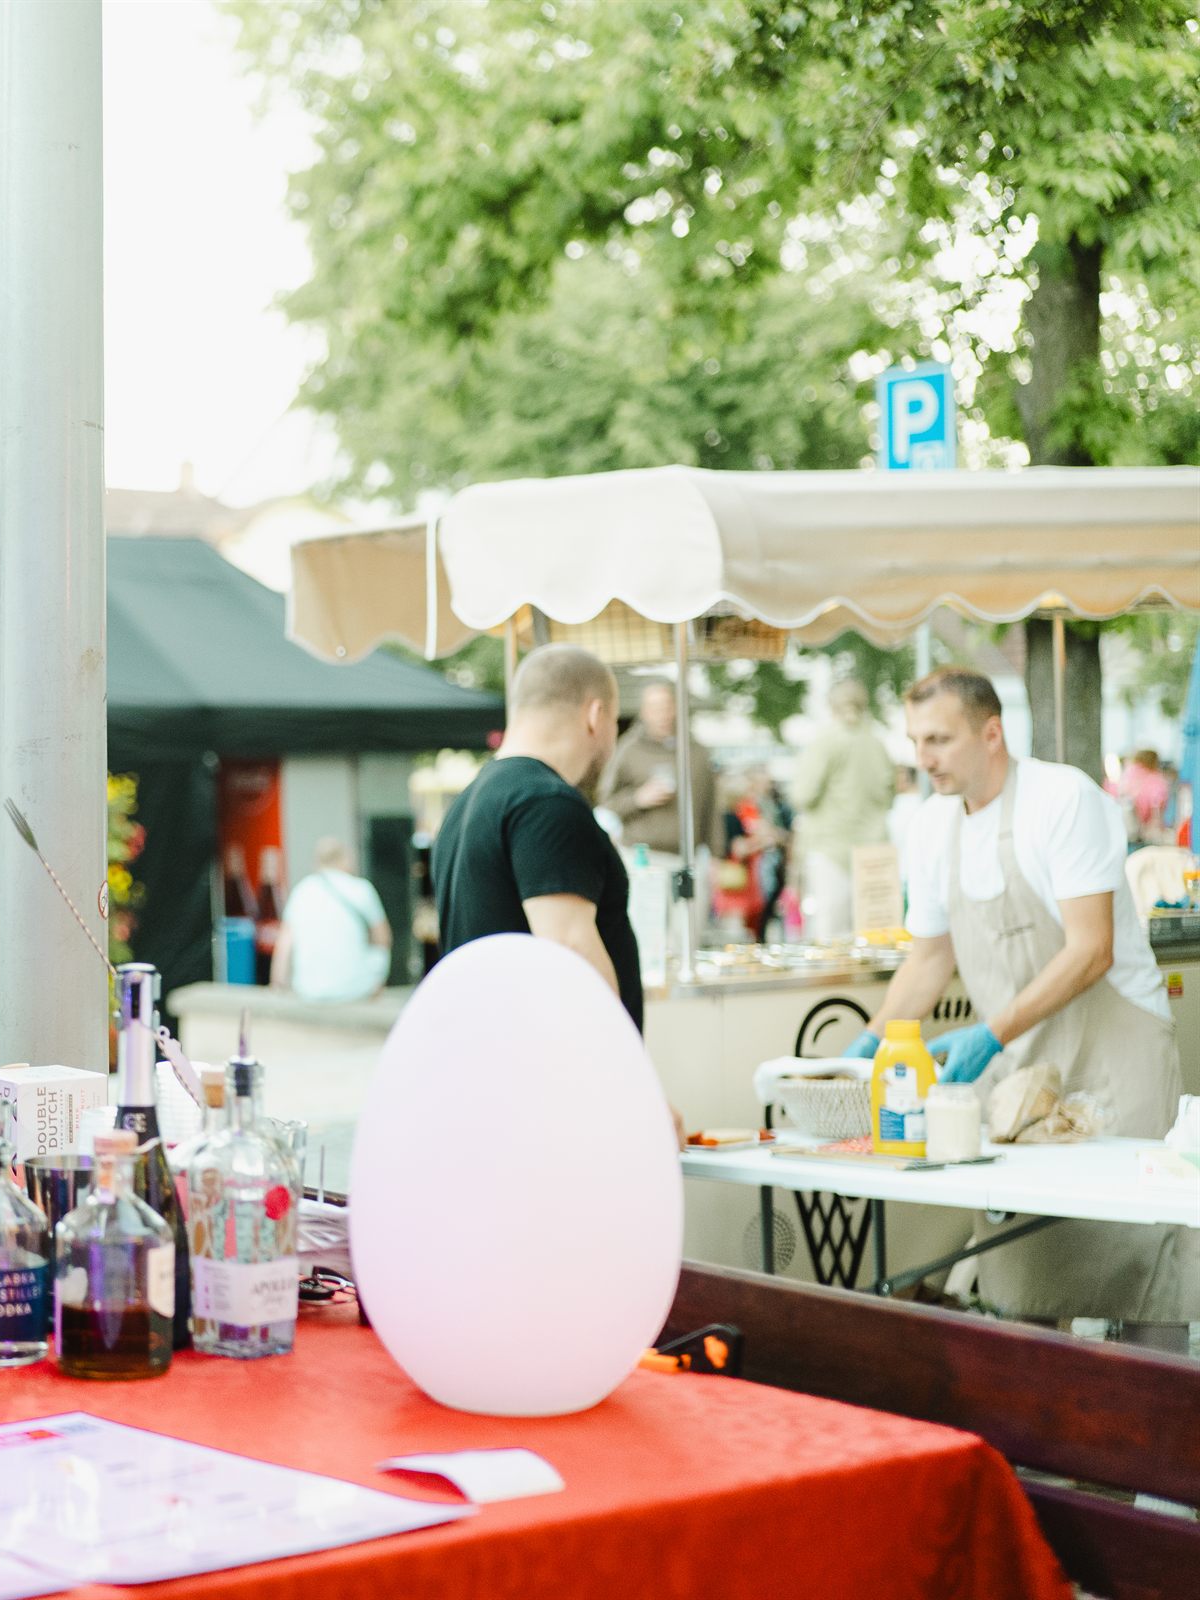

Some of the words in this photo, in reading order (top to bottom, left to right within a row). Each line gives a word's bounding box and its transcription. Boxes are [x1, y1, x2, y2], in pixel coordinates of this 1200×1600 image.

[892, 379, 939, 463] P
[37, 1087, 47, 1155] DOUBLE
[48, 1091, 58, 1148] DUTCH
